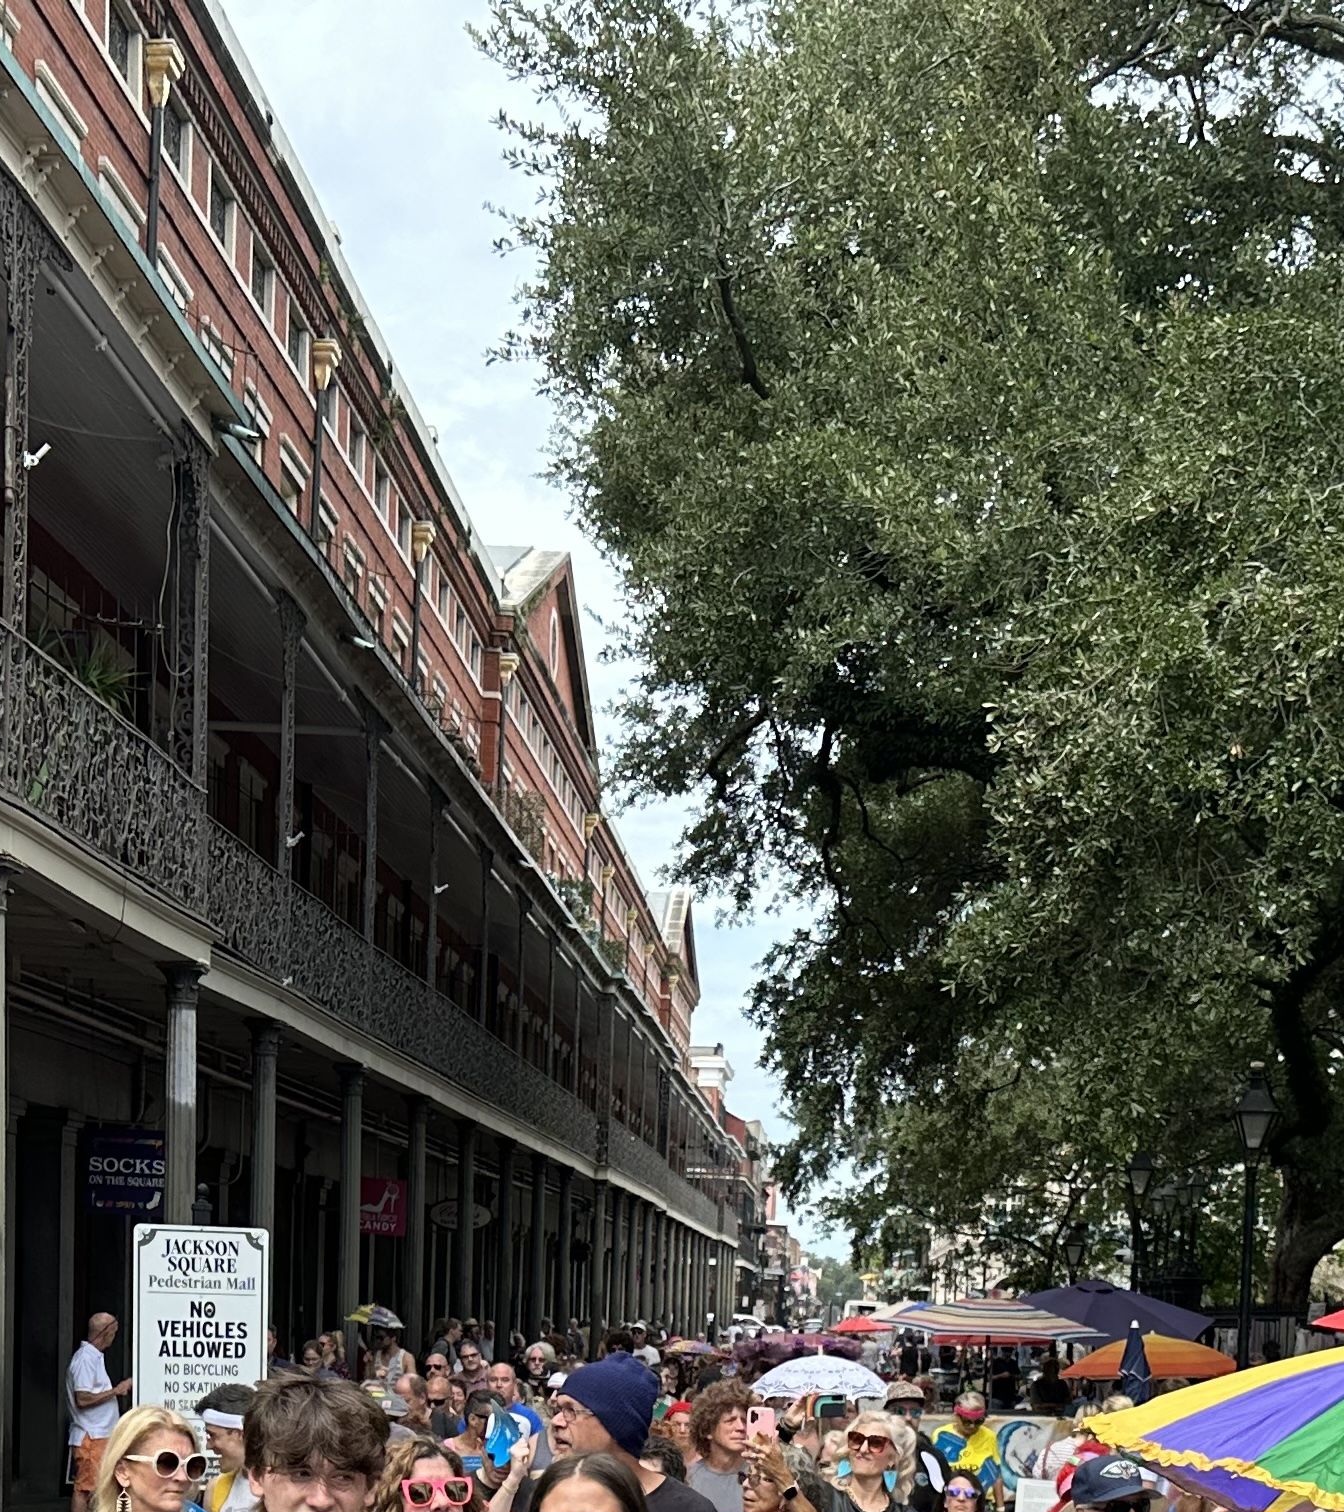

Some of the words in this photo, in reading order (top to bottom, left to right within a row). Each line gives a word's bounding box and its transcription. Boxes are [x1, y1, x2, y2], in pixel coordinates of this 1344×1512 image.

[88, 1156, 165, 1175] SOCKS
[88, 1174, 103, 1184] ON
[105, 1175, 125, 1186] THE
[127, 1176, 165, 1188] SQUARE
[161, 1239, 239, 1258] JACKSON
[167, 1256, 237, 1276] SQUARE
[148, 1275, 222, 1289] Pedestrian
[226, 1277, 256, 1290] Mall
[190, 1301, 216, 1319] NO
[157, 1320, 248, 1339] VEHICLES
[158, 1340, 246, 1359] ALLOWED
[164, 1363, 180, 1375] NO
[183, 1364, 239, 1377] BICYCLING
[164, 1381, 180, 1393] NO
[183, 1382, 227, 1393] SKATIN
[164, 1399, 176, 1410] NO
